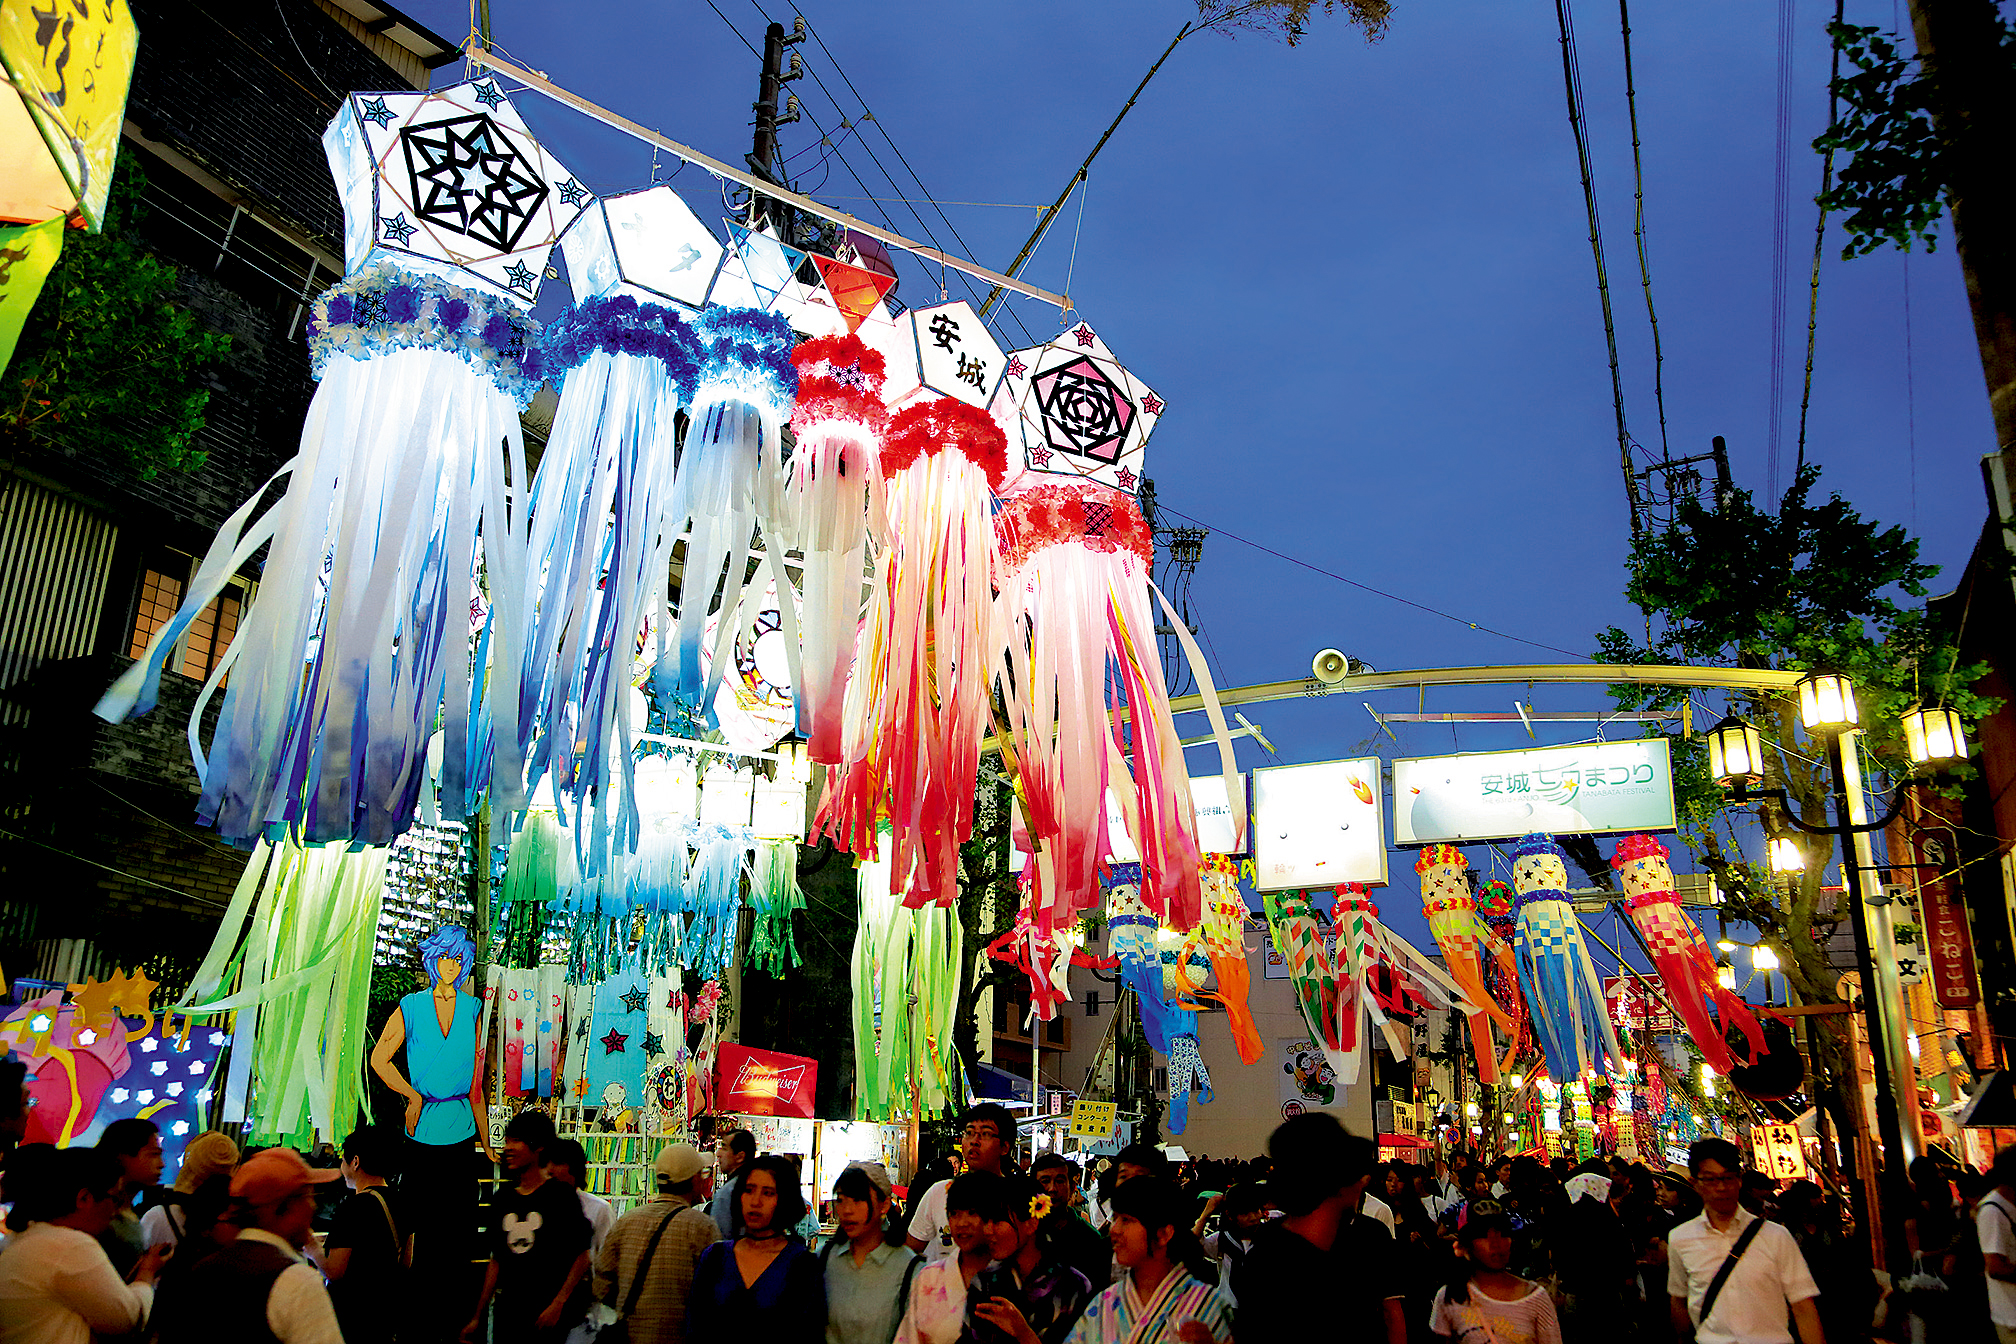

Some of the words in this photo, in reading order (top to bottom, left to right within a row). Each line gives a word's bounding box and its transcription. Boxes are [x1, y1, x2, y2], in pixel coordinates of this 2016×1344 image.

[928, 313, 987, 397] 安城
[1481, 761, 1655, 806] 安城七夕まつり
[1582, 789, 1621, 798] TANABATA
[1622, 786, 1656, 795] FESTIVAL
[1517, 794, 1539, 802] ANJO
[1938, 920, 1964, 980] こねこ
[739, 1064, 799, 1091] Budweiser
[1078, 1113, 1108, 1123] コンクール
